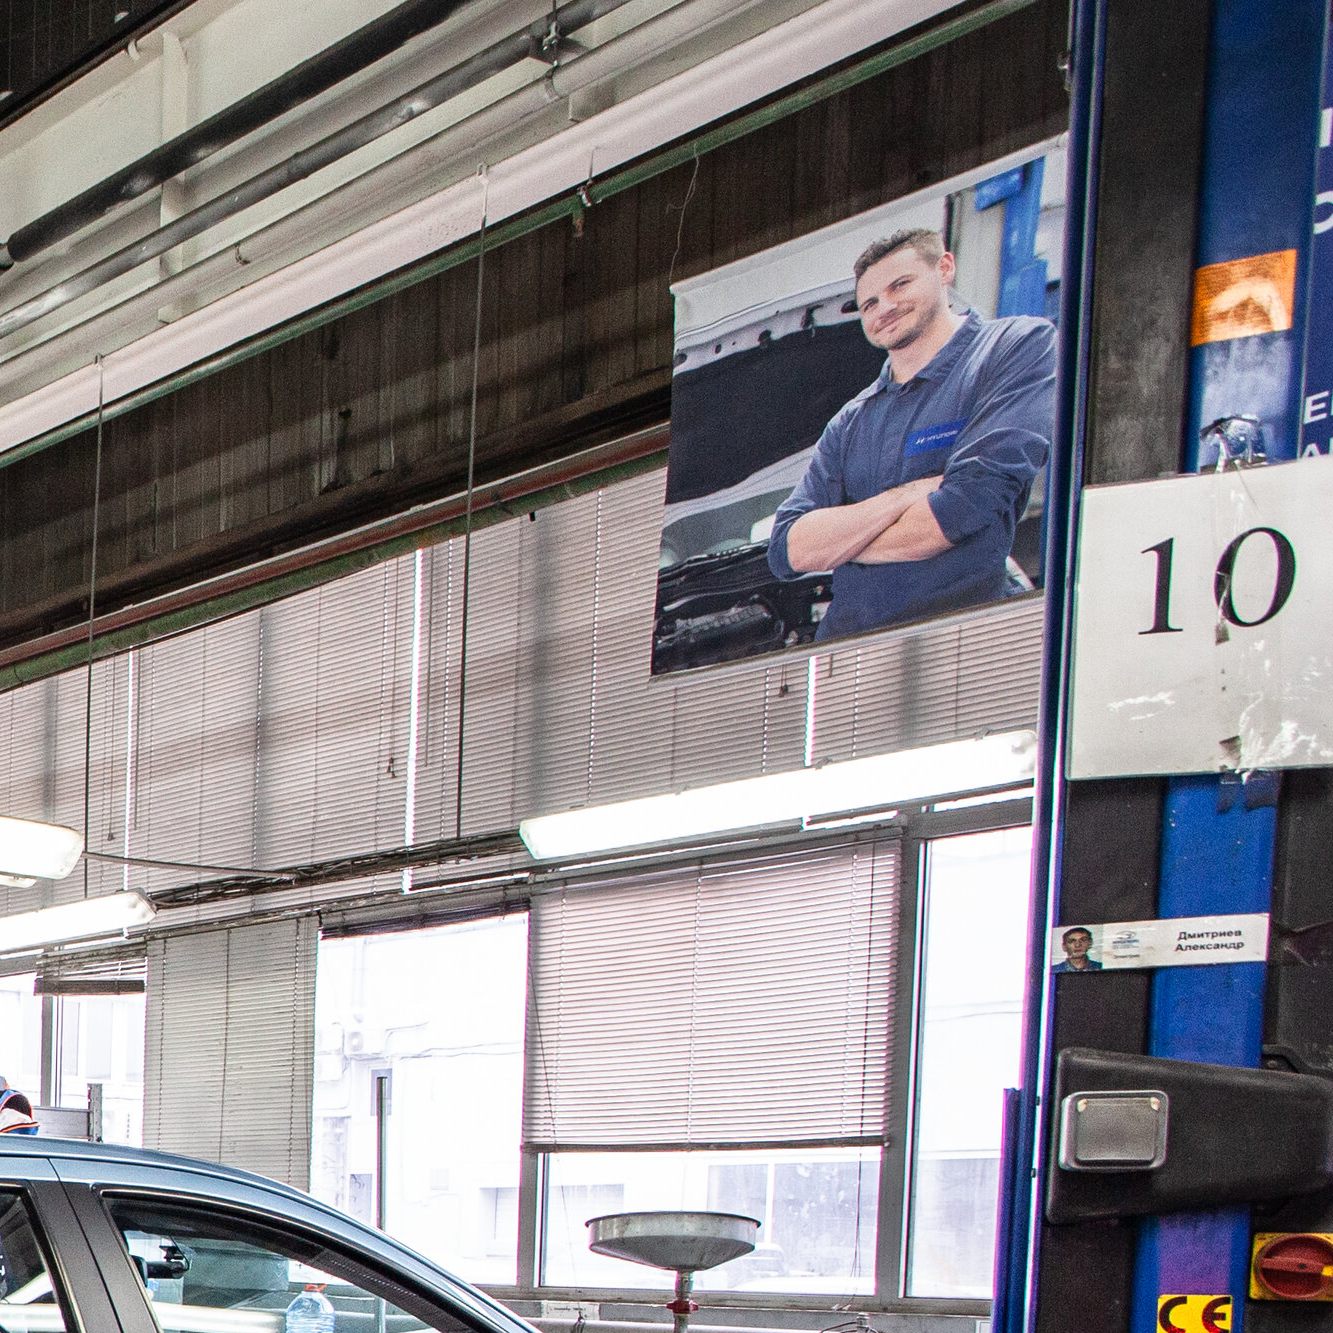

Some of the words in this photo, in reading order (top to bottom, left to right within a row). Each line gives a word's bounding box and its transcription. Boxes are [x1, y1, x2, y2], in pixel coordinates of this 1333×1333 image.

[1138, 526, 1297, 636] 10
[1177, 928, 1243, 941] Дмитриев
[1175, 940, 1245, 952] Александр
